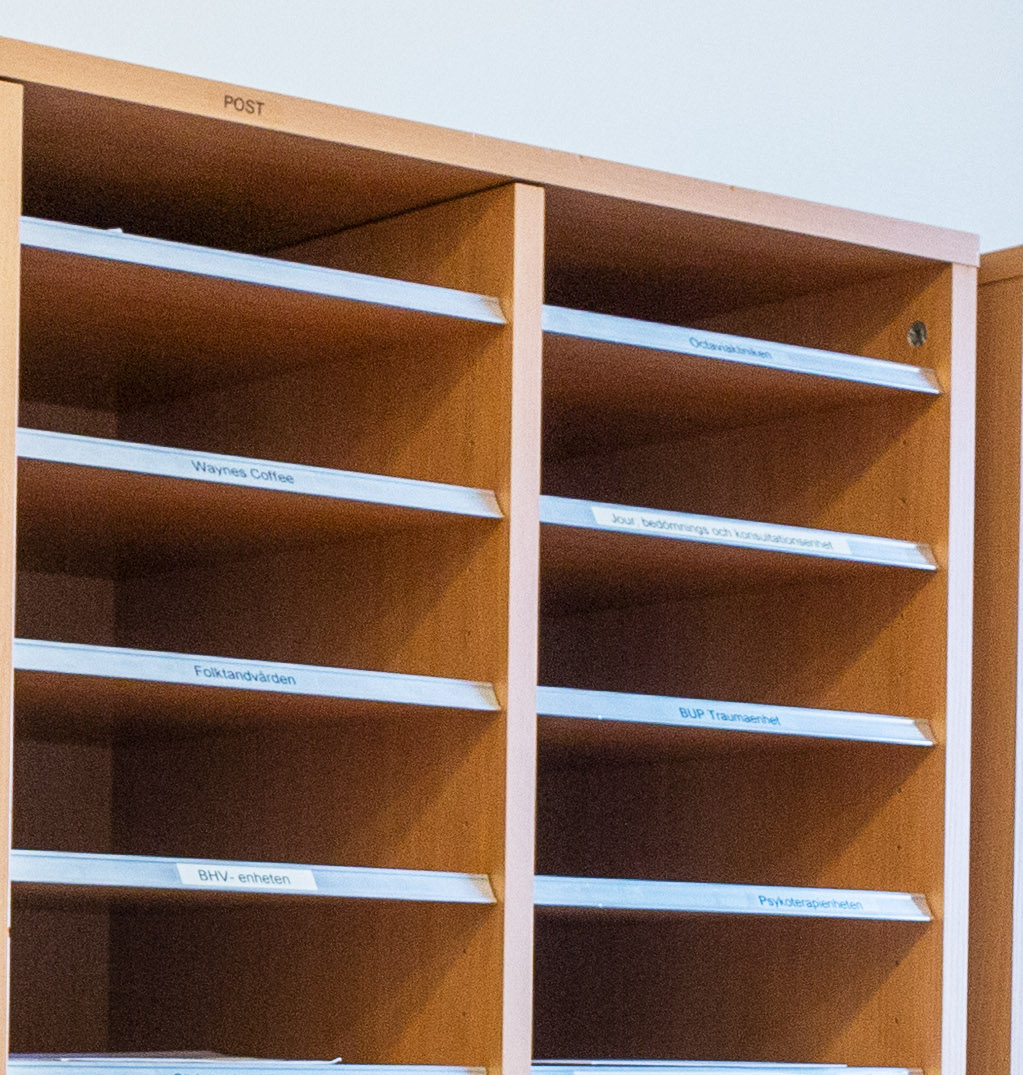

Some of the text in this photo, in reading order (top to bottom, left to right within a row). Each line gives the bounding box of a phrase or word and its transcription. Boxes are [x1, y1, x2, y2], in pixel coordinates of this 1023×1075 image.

[223, 94, 265, 117] POST
[191, 459, 295, 485] Waynes Coffee
[711, 527, 733, 538] och
[193, 664, 297, 687] Folktandvården
[678, 706, 781, 727] BUP Traumaenhet
[197, 868, 292, 888] BHV- enheten
